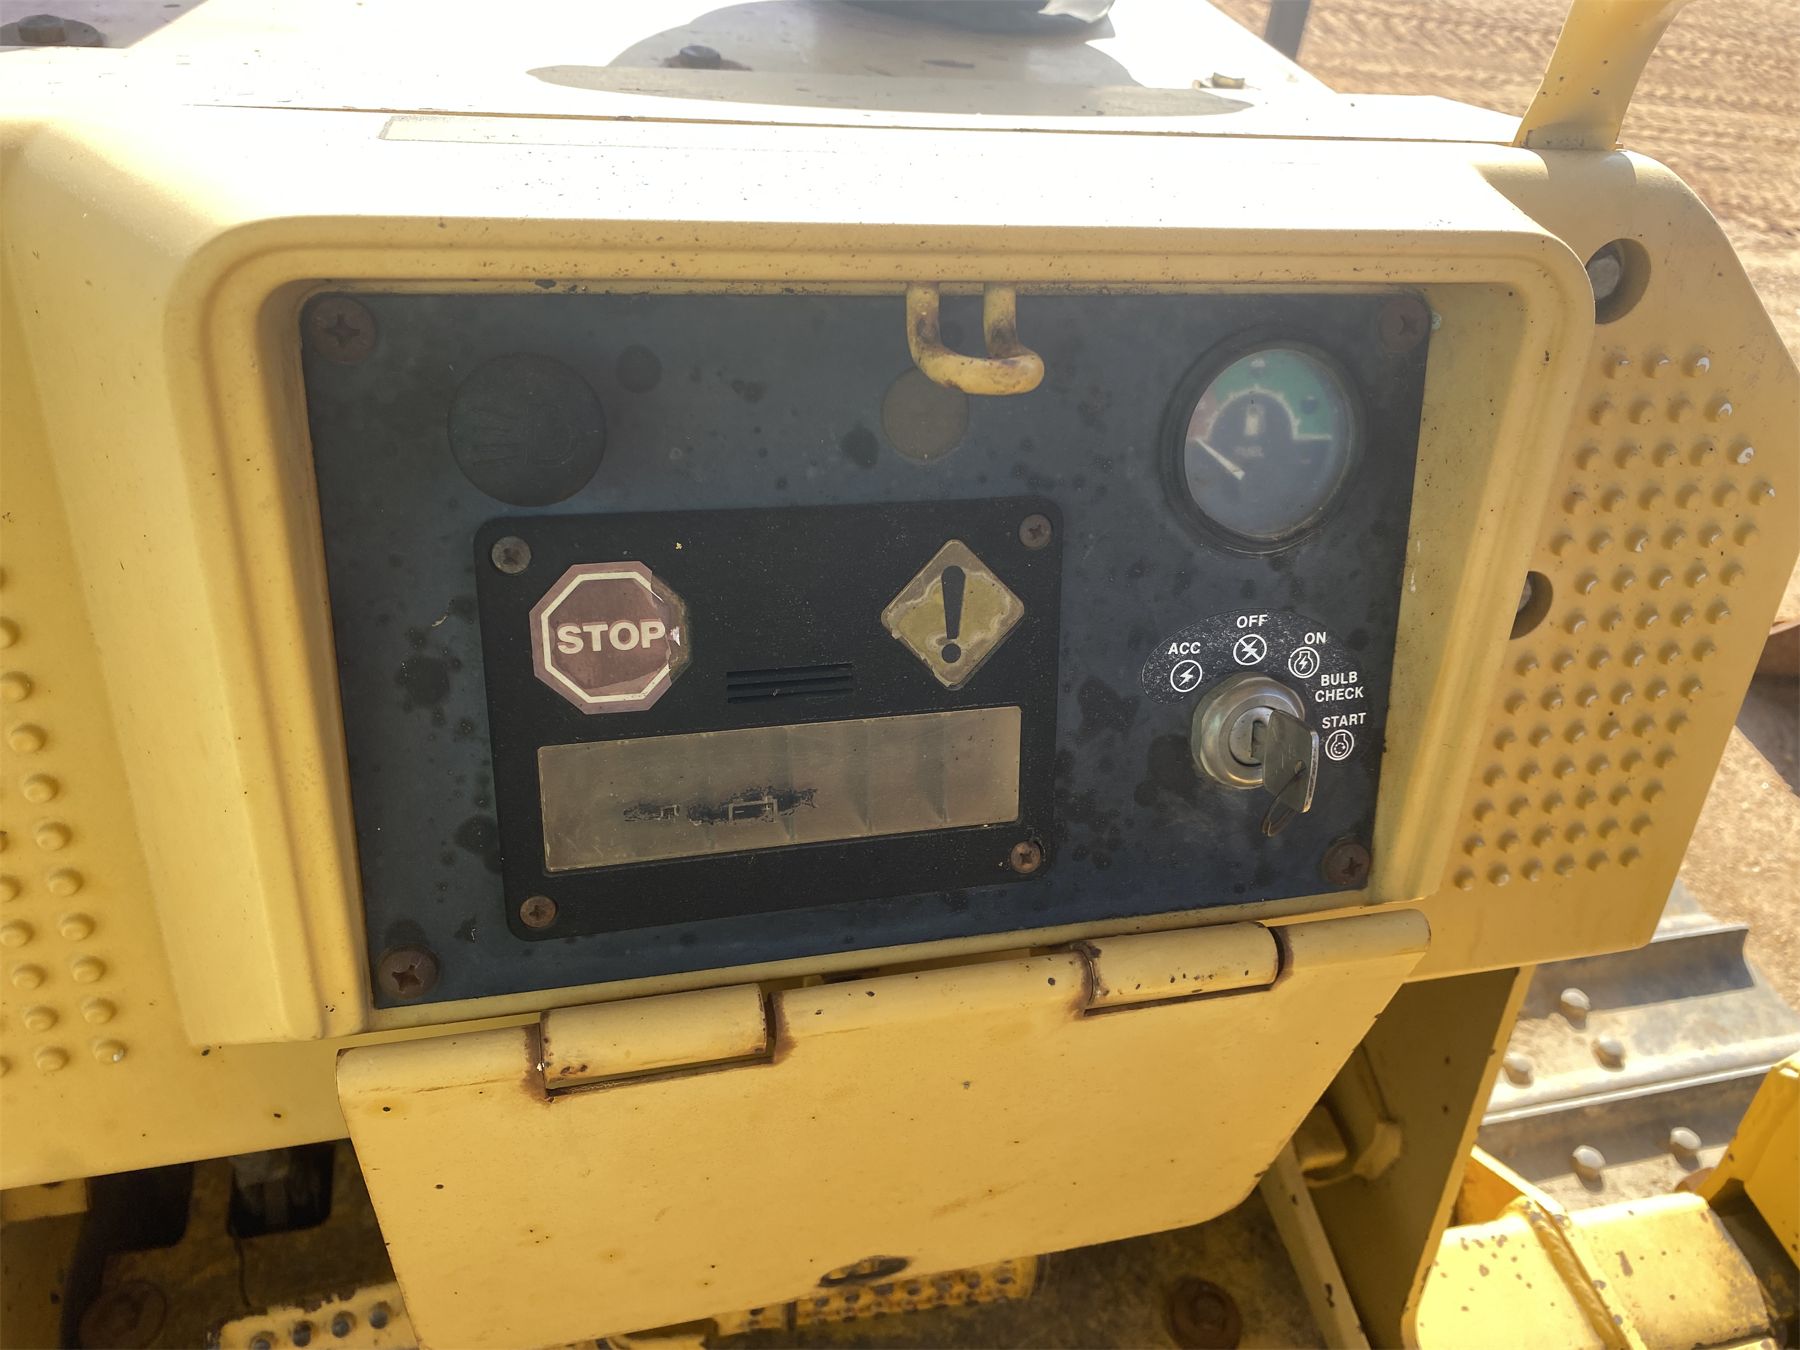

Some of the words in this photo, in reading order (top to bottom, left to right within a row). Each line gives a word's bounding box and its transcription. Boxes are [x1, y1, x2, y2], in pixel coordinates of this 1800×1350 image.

[1236, 614, 1268, 628] OFF
[557, 622, 665, 654] STOP
[1304, 632, 1327, 645] ON
[1168, 642, 1201, 655] ACC
[1320, 671, 1358, 687] BULB
[1314, 687, 1364, 703] CHECK
[1321, 712, 1367, 729] START
